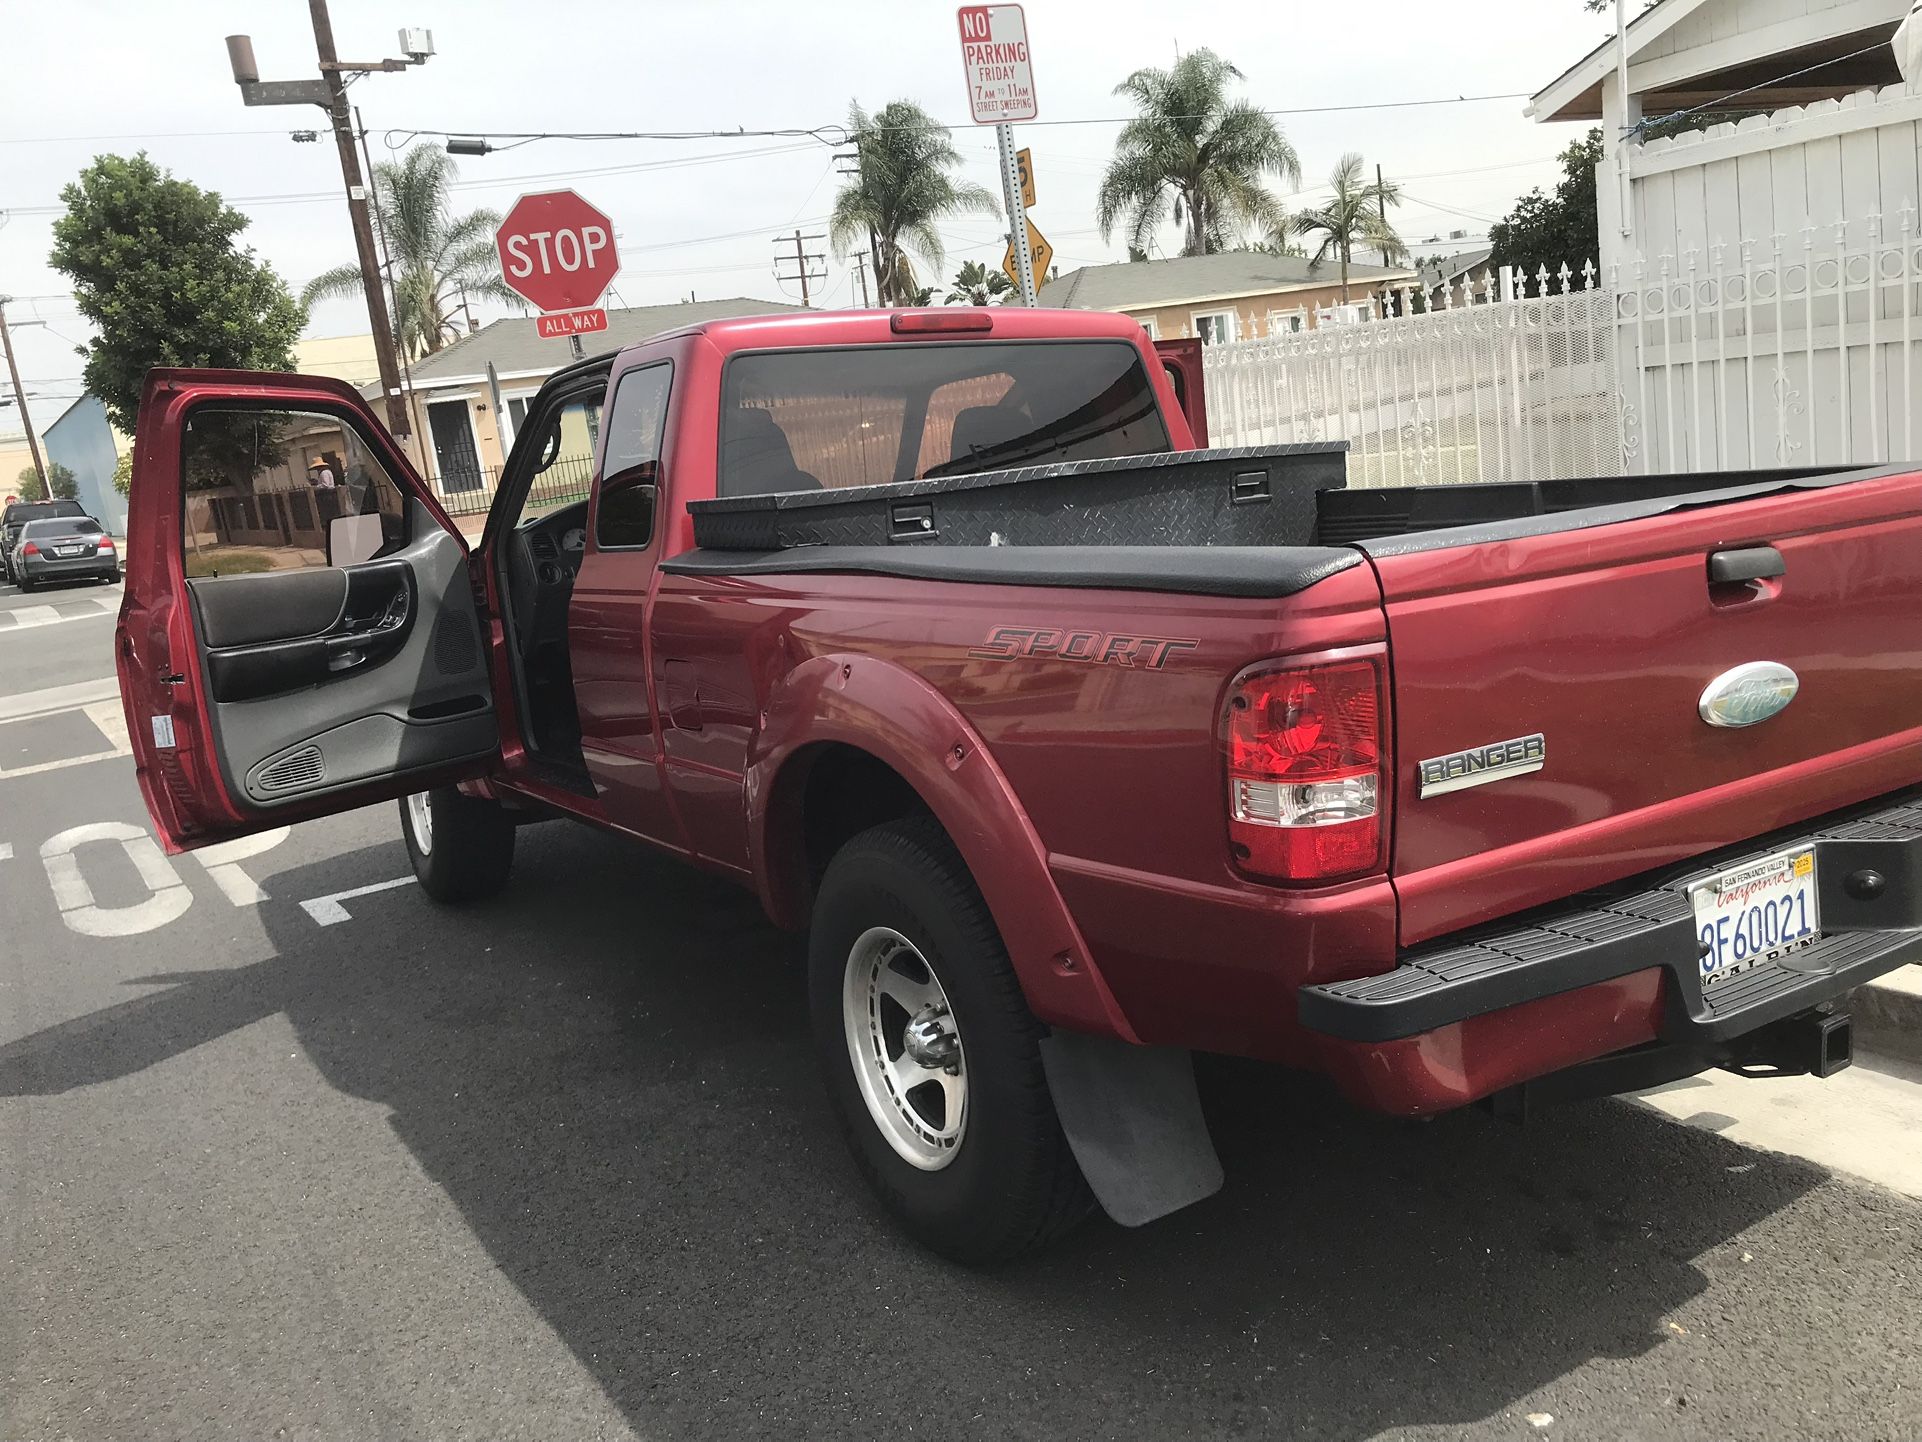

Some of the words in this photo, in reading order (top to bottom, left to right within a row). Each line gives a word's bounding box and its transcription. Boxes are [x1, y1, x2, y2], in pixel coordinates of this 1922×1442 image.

[963, 12, 987, 38] NO
[966, 42, 1027, 66] PARKING
[979, 66, 1015, 82] FRIDAY
[976, 100, 999, 113] STREET
[1000, 98, 1032, 111] SWEEPING
[1016, 156, 1028, 188] 5
[507, 225, 607, 278] STOP
[1010, 245, 1045, 271] BMP
[545, 319, 570, 334] ALL
[572, 314, 599, 330] WAY
[967, 624, 1201, 670] SPORT
[1424, 735, 1544, 784] RANGER
[1724, 877, 1737, 887] SAN
[1737, 866, 1766, 883] FERNANDO
[1767, 859, 1786, 873] VALLEY
[1717, 872, 1793, 908] California
[1701, 888, 1811, 973] 8F60021
